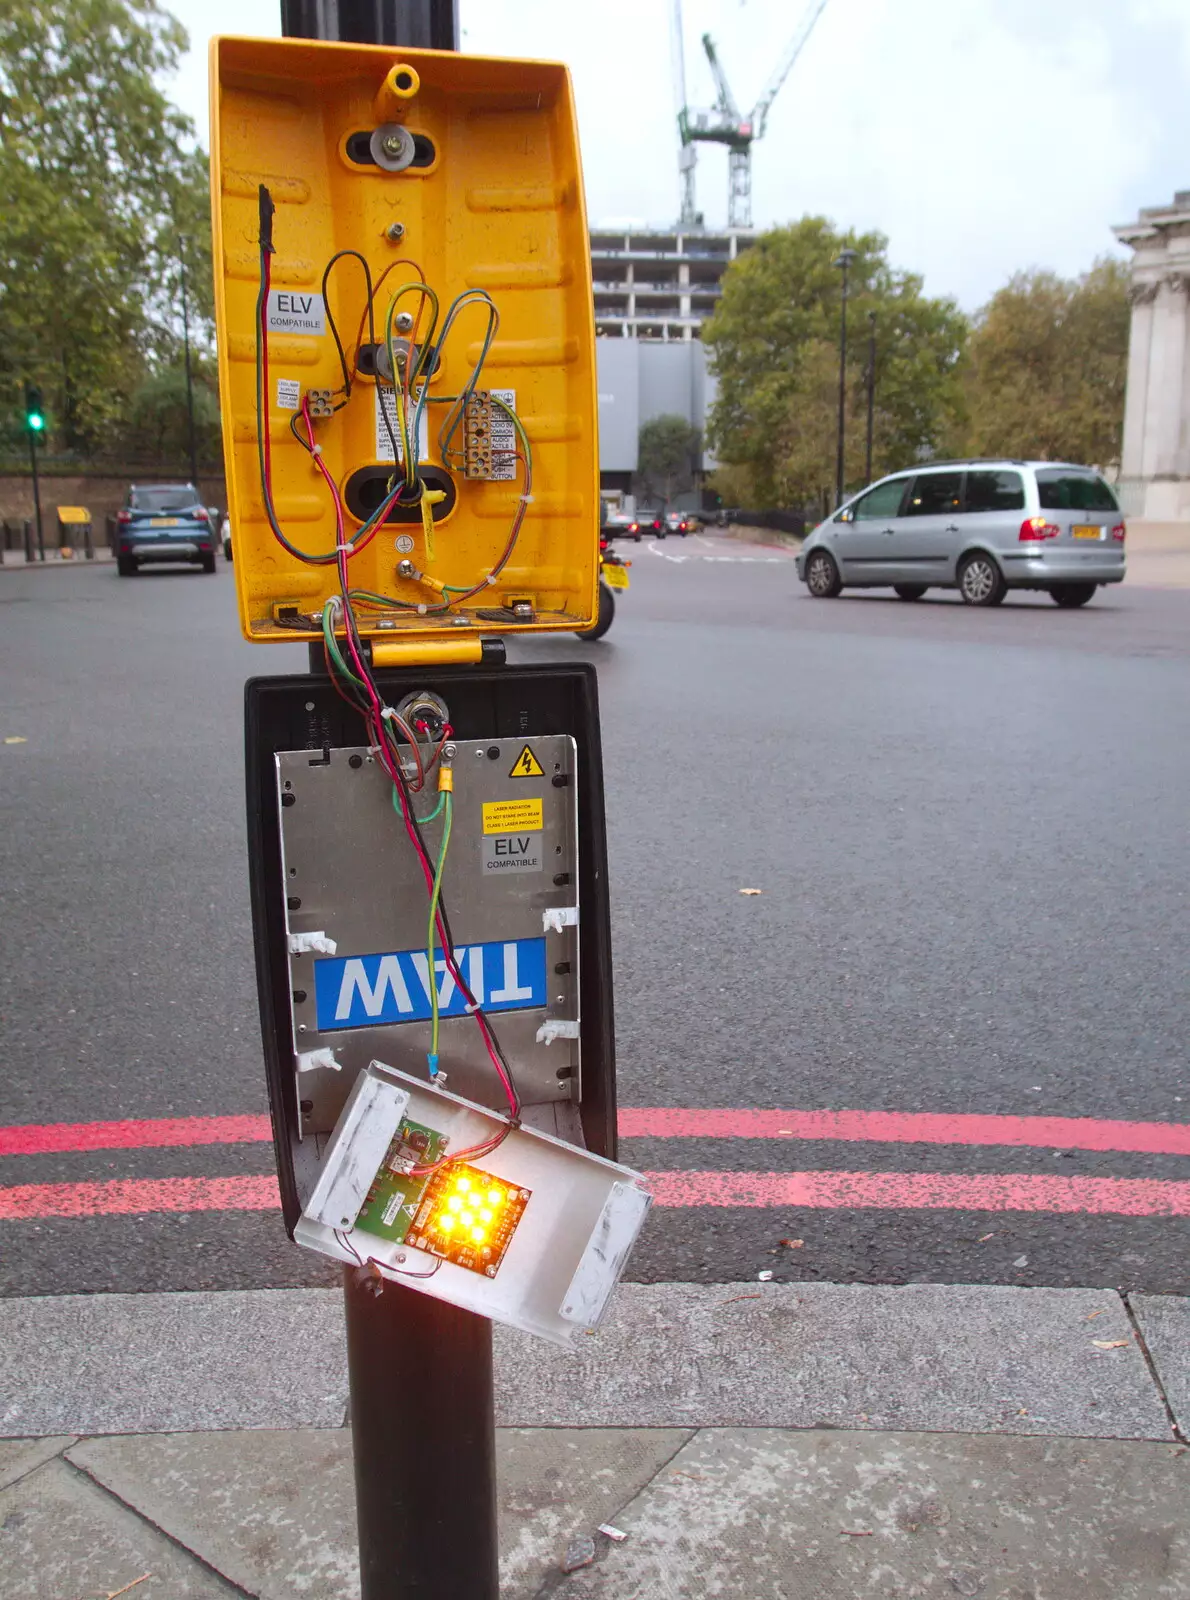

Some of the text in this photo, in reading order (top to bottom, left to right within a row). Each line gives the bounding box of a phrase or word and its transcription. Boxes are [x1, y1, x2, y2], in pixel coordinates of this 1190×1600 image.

[277, 294, 313, 314] ELV
[270, 317, 321, 329] COMPATIBLE
[380, 387, 422, 395] SIES
[495, 837, 531, 856] ELV
[487, 858, 538, 869] COMPATIBLE
